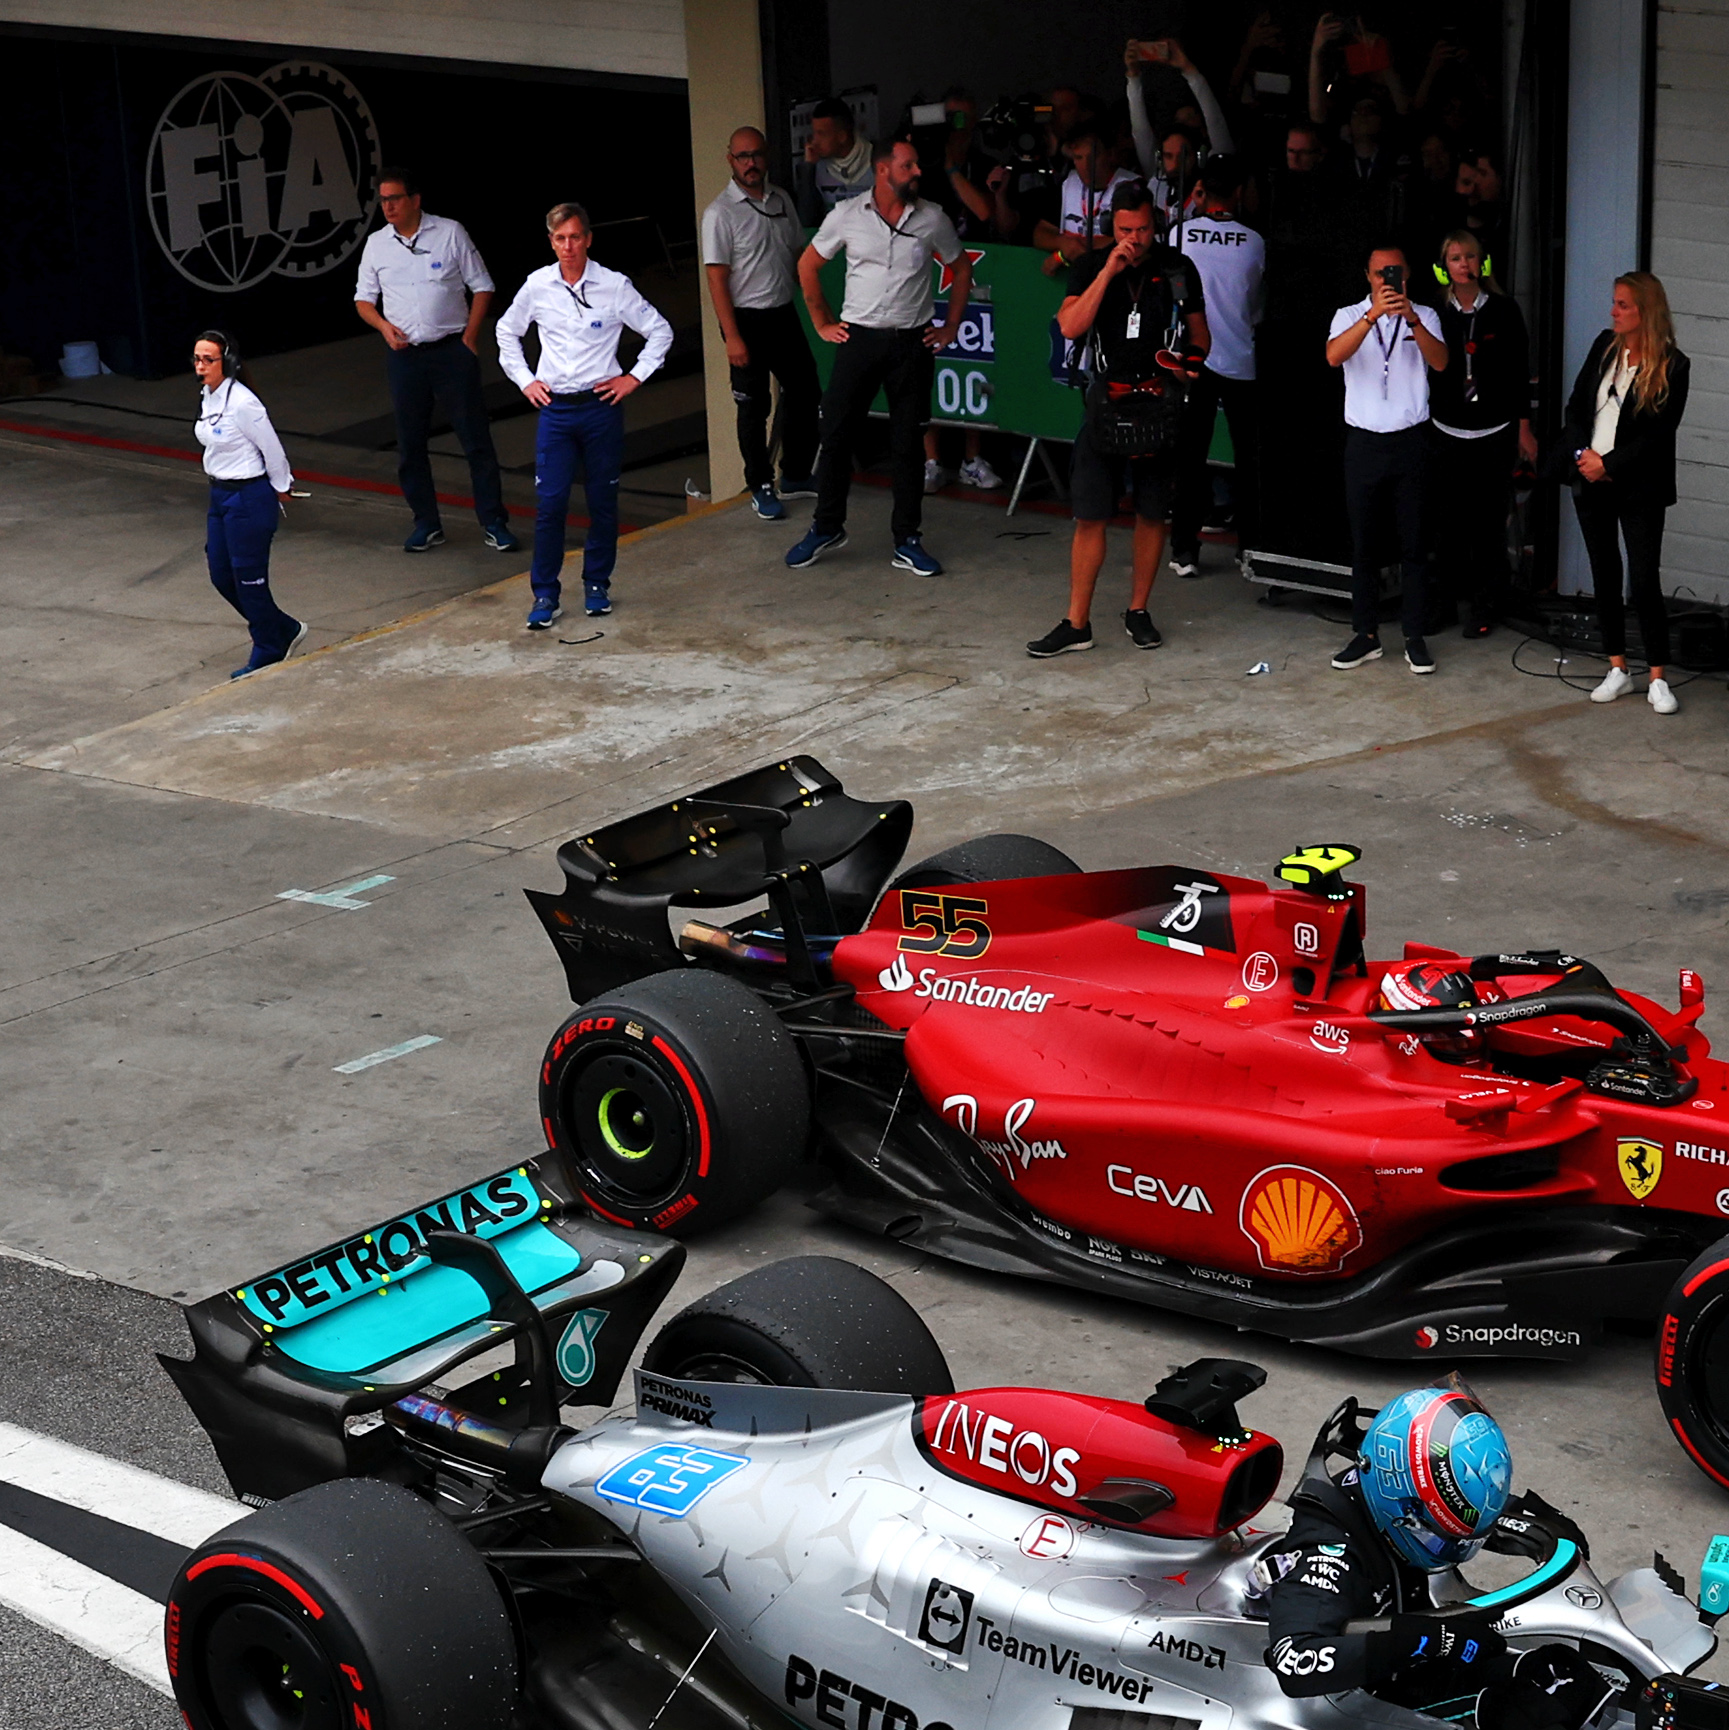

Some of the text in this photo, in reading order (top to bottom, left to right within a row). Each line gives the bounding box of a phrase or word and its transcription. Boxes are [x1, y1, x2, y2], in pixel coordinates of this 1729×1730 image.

[1187, 228, 1248, 247] STAFF
[897, 889, 992, 959] 55
[914, 967, 1055, 1016] Santander
[1479, 1003, 1546, 1023] Snapdragon
[1313, 1019, 1350, 1045] aws
[1610, 1082, 1646, 1096] Santander
[1031, 1211, 1071, 1240] brembo
[254, 1174, 528, 1321] PETRONAS
[1088, 1237, 1122, 1256] NGK
[1445, 1322, 1581, 1349] Snapdragon
[641, 1376, 713, 1409] PETRONAS
[639, 1392, 716, 1430] PRIMAX
[930, 1400, 1080, 1498] INEOS
[594, 1444, 751, 1518] 63
[977, 1616, 1154, 1705] TeamViewer
